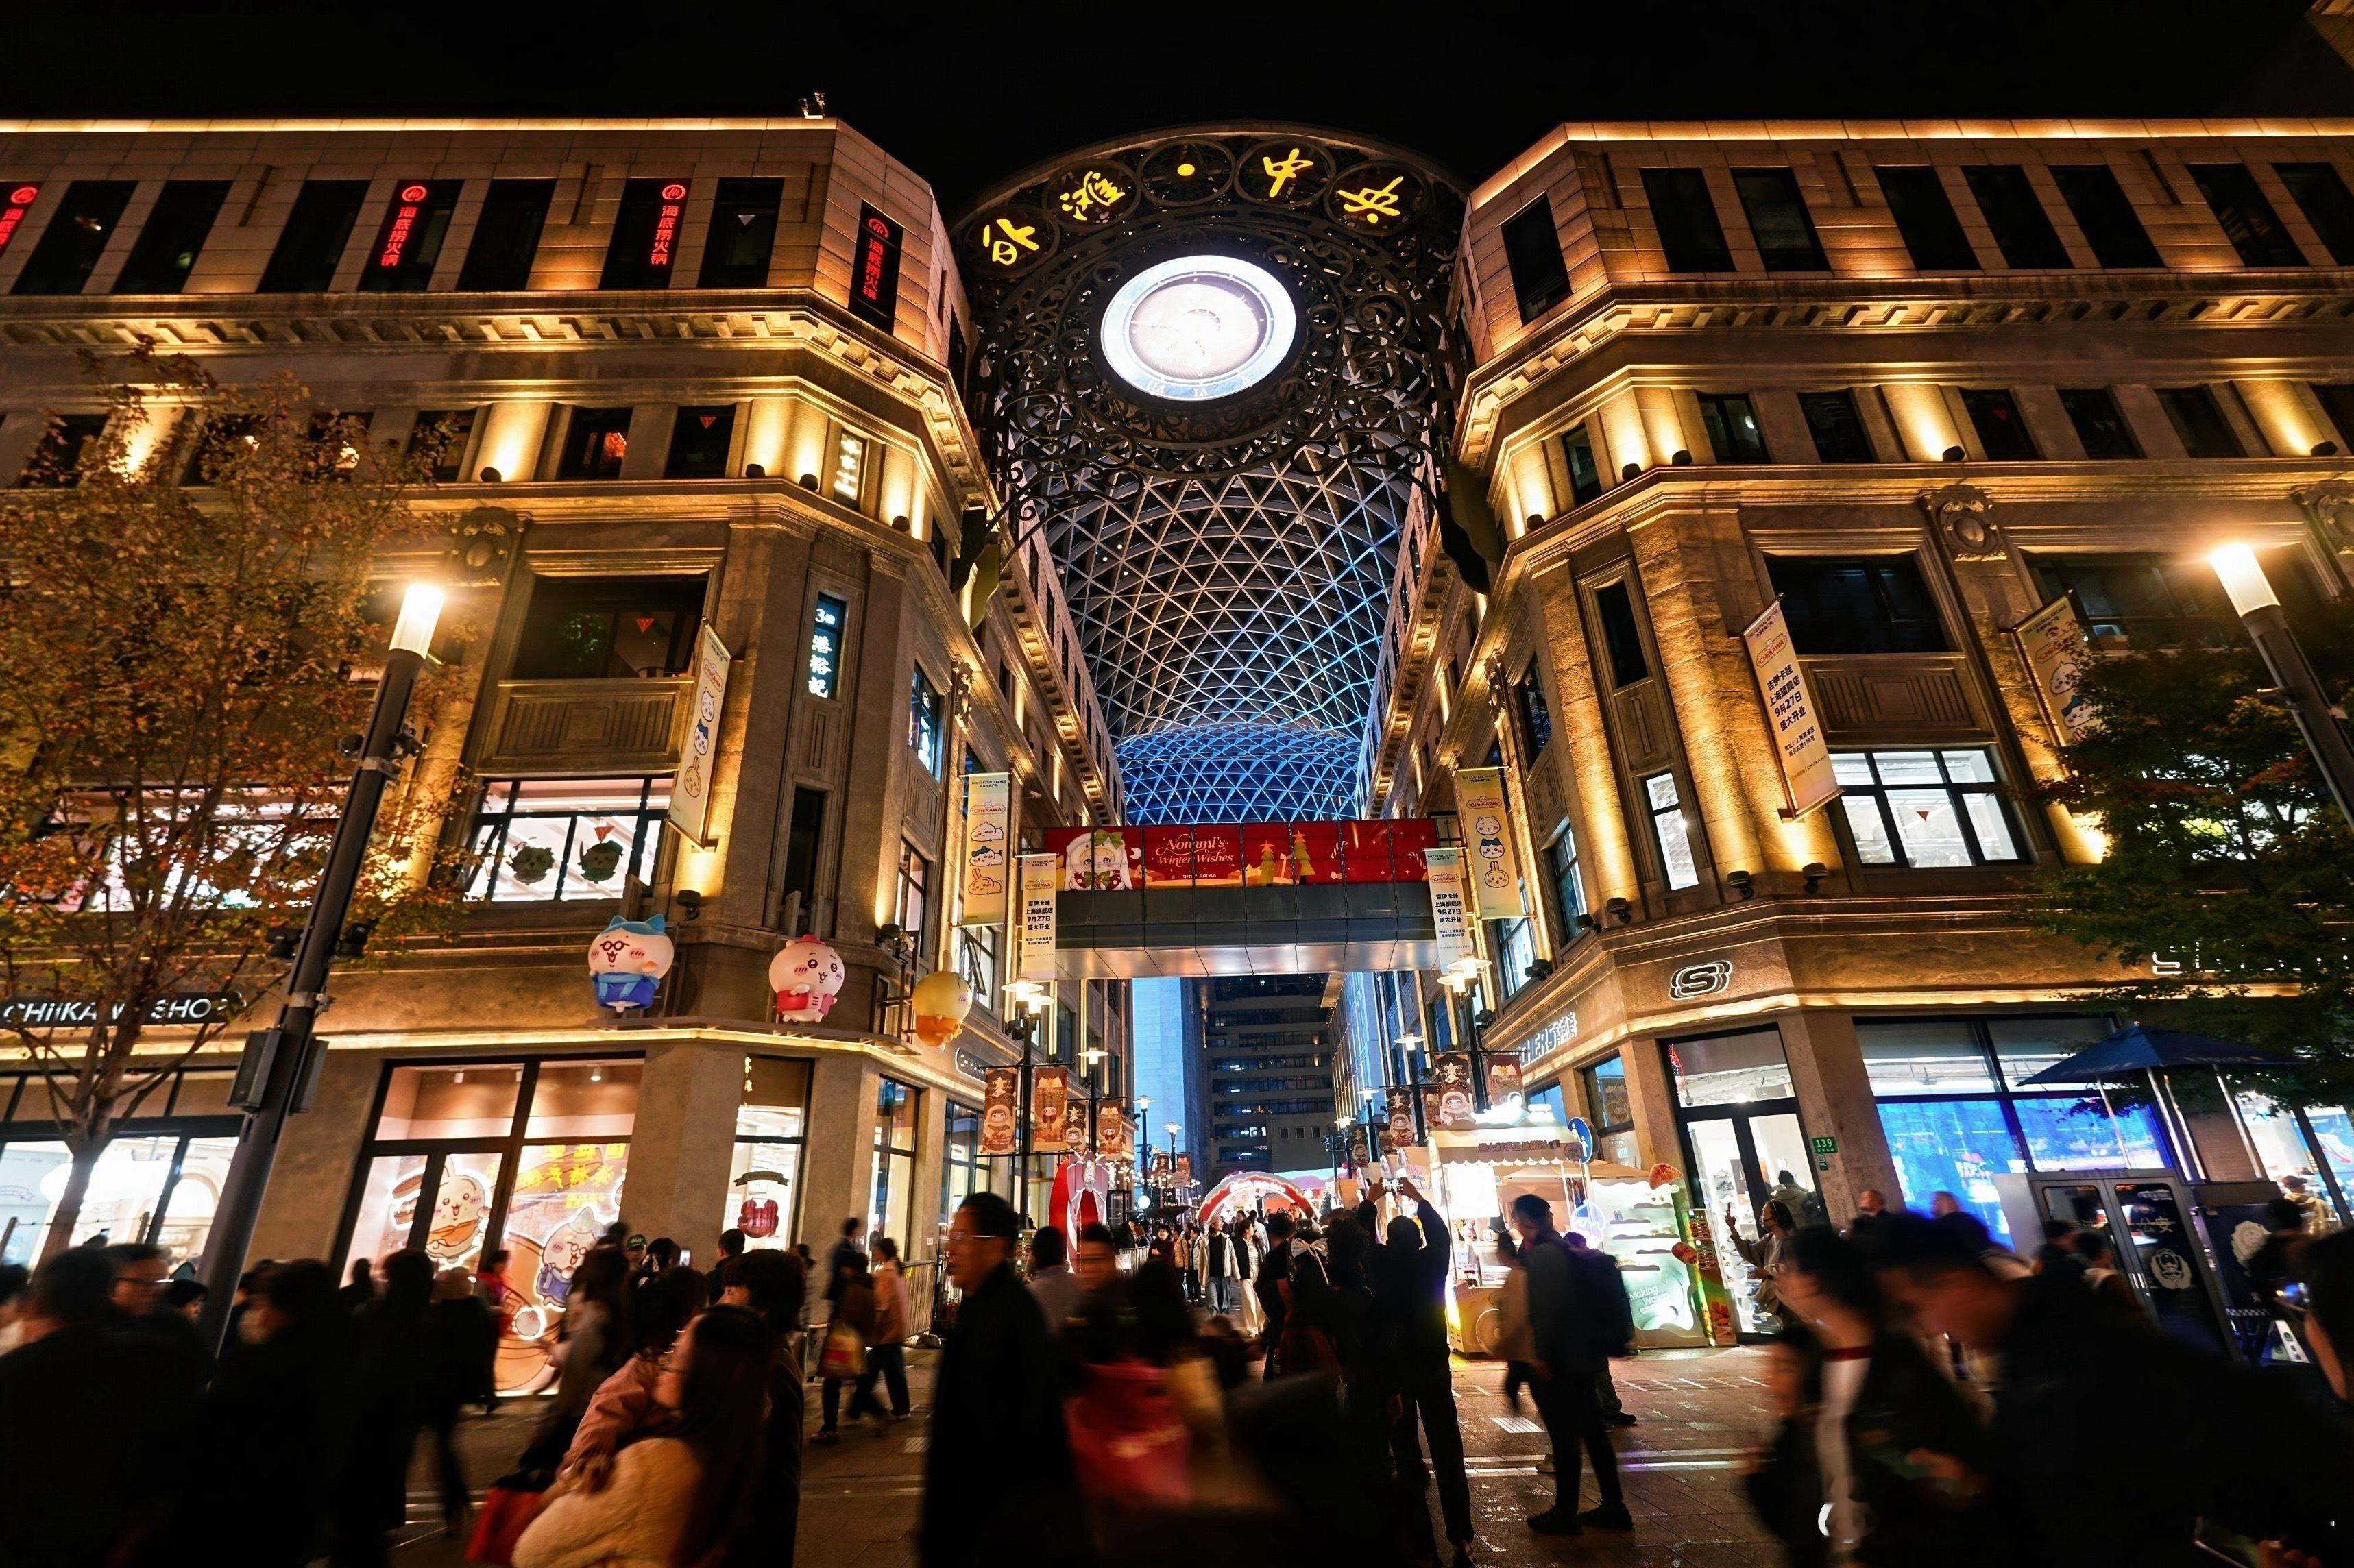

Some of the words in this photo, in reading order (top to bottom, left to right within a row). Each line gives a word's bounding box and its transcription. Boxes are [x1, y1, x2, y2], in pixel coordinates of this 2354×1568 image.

[381, 207, 417, 267] 海底捞火锅
[651, 206, 679, 265] 海底捞火锅
[1767, 664, 1793, 691] 吉伊卡哇
[1769, 674, 1801, 707] 上海旗舰店
[1775, 691, 1803, 718] 9月27日
[1158, 855, 1192, 868] Winter
[1196, 848, 1234, 863] Wishes
[1816, 1138, 1833, 1148] 139
[1629, 1286, 1658, 1301] Making
